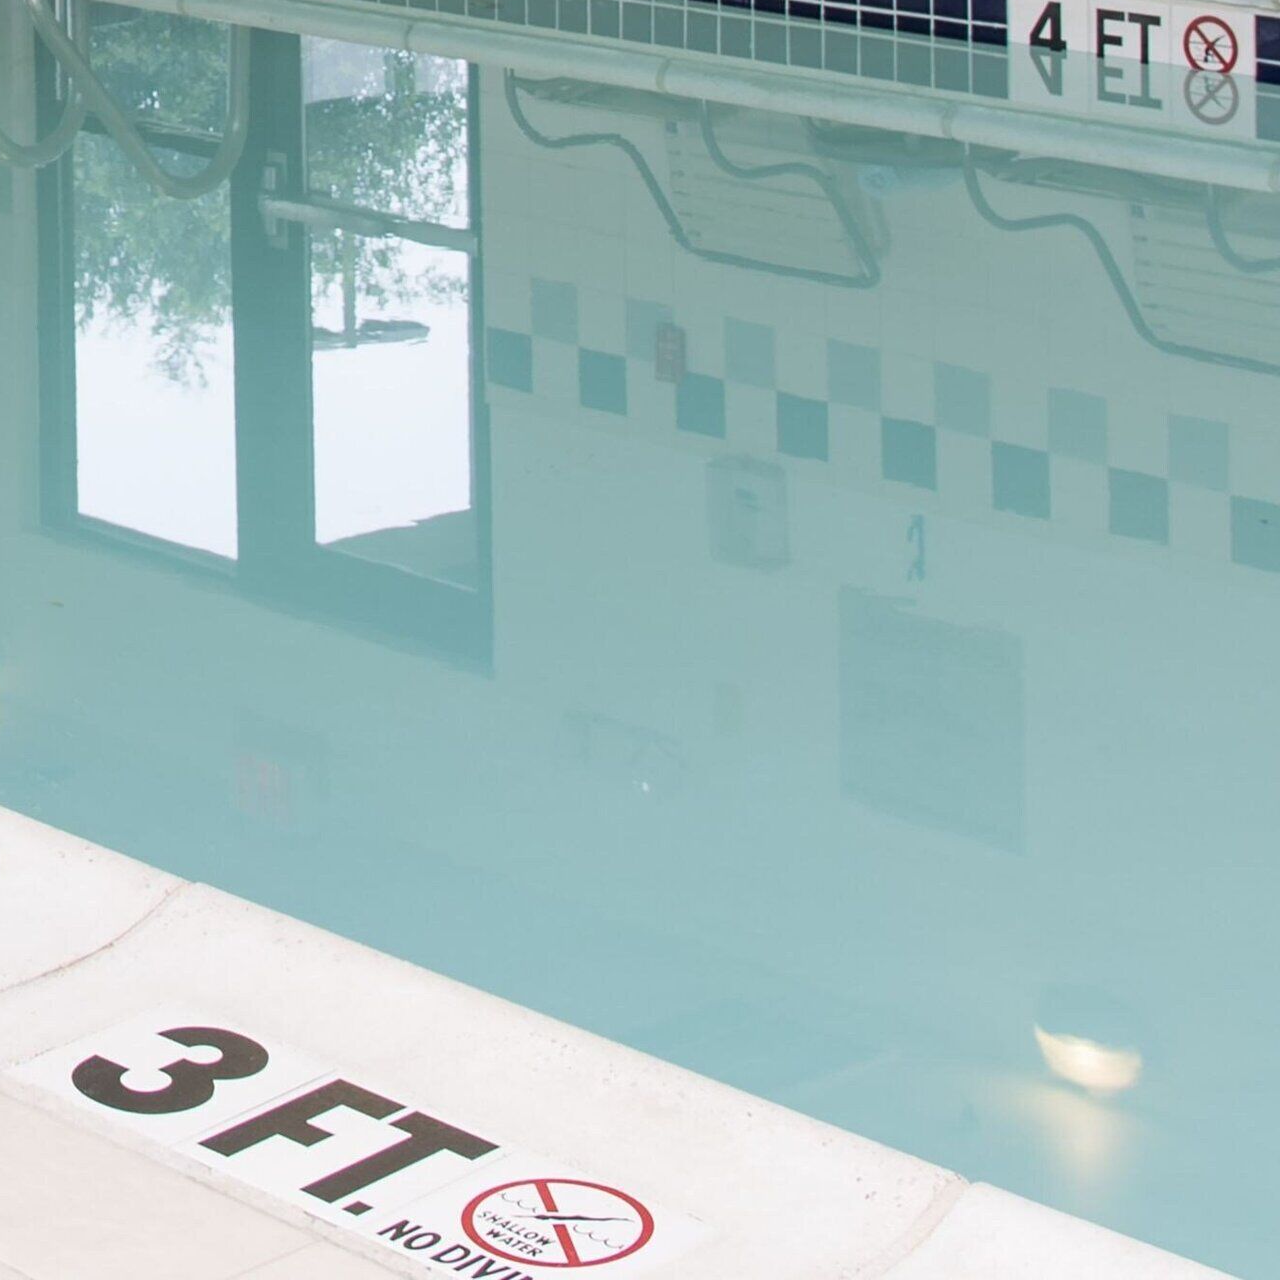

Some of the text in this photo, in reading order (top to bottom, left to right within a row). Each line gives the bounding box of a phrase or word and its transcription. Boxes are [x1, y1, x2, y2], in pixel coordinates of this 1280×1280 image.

[1029, 1, 1162, 65] 4 FT
[71, 1026, 502, 1217] 3 FT.
[376, 1220, 533, 1280] NO DIVI
[477, 1211, 555, 1246] SHALLOW
[486, 1229, 544, 1257] WATER
